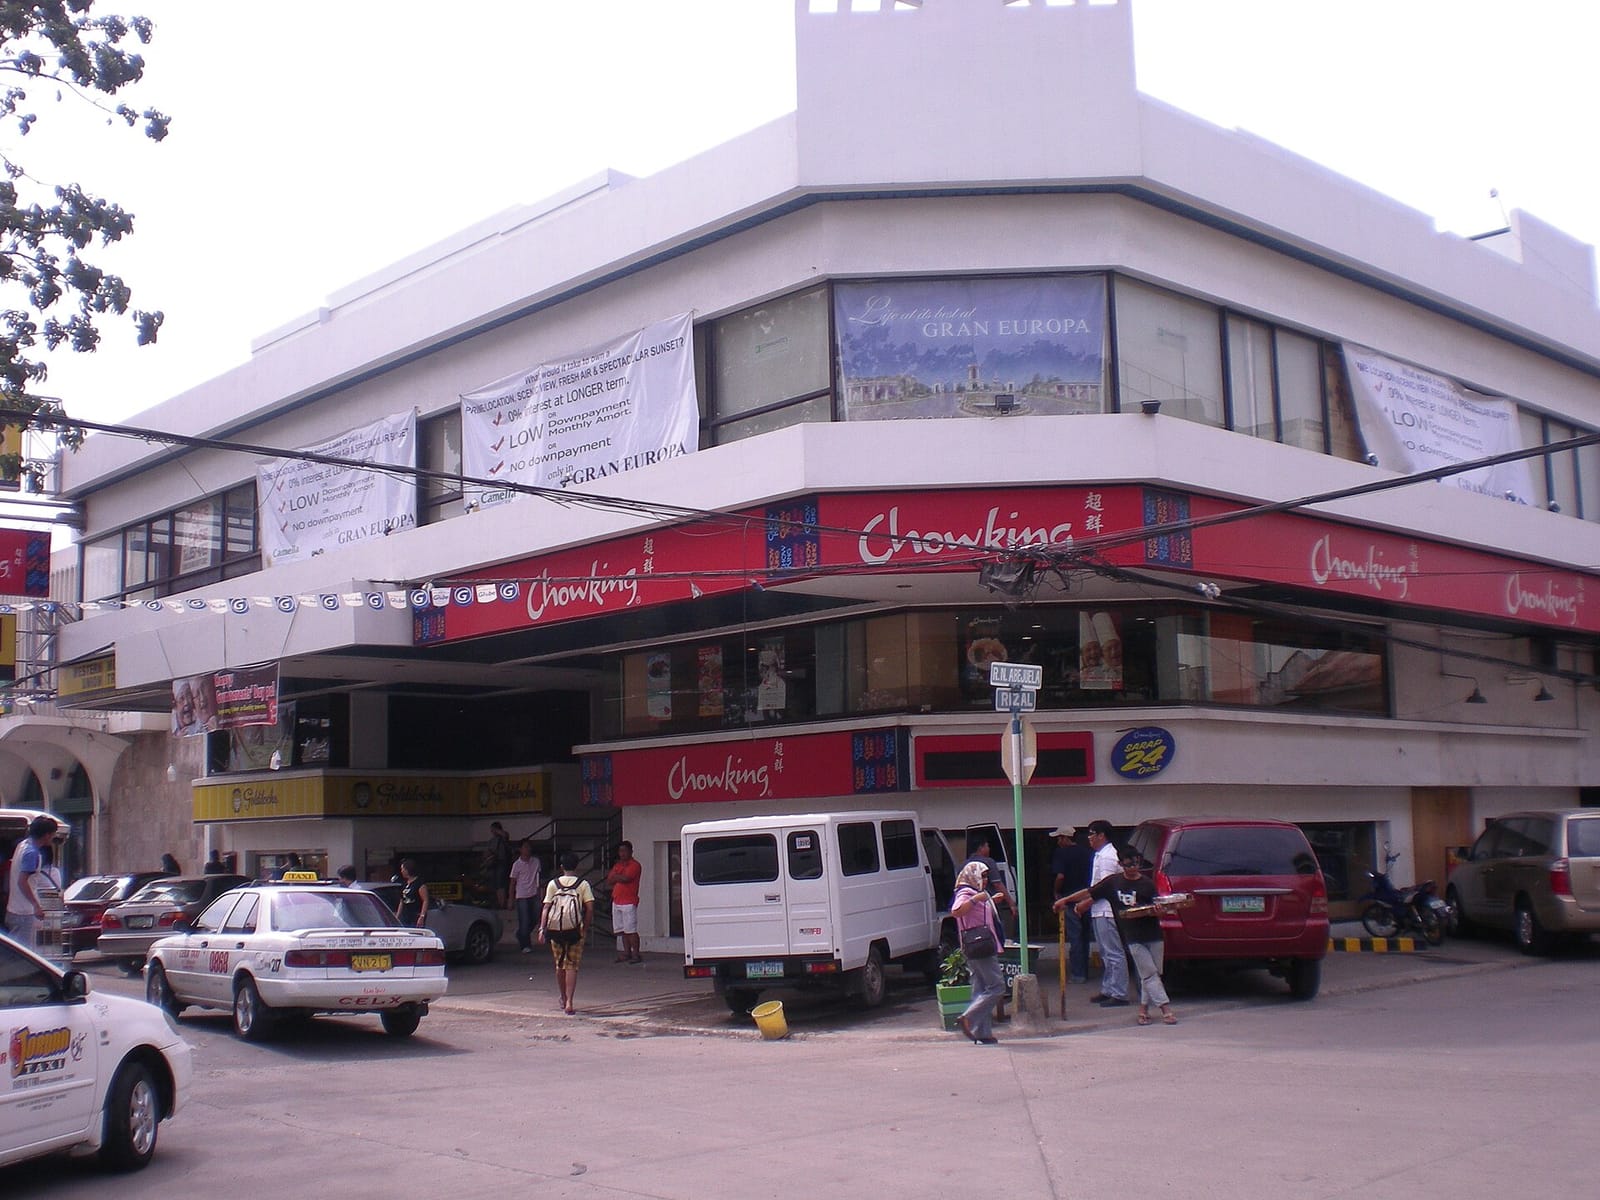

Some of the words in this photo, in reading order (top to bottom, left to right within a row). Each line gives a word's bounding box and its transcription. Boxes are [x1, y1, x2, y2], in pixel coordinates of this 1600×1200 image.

[923, 321, 989, 338] GRAN
[999, 318, 1090, 336] EUROPA
[558, 374, 580, 387] FRESH
[580, 370, 592, 381] AIR
[593, 366, 598, 376] &
[650, 337, 684, 357] SUNSET?
[508, 409, 522, 423] 0%
[554, 396, 564, 407] at
[566, 382, 604, 403] LONGER
[548, 398, 631, 428] Downpayment
[548, 419, 592, 437] Monthly
[595, 408, 632, 425] Amort.
[1391, 409, 1429, 432] LOW
[509, 424, 544, 449] LOW
[510, 461, 525, 473] NO
[528, 437, 612, 469] downpayment
[573, 459, 620, 485] GRAN
[623, 441, 687, 471] EUROPA
[289, 491, 320, 511] LOW
[292, 521, 305, 531] NO
[307, 505, 364, 529] downpayment
[338, 524, 367, 544] GRAN
[370, 512, 415, 536] EUROPA
[858, 506, 1073, 565] Chowking
[1311, 534, 1408, 599] Chowking
[527, 560, 638, 620] Chowking
[1505, 570, 1577, 625] Chowking
[992, 664, 1008, 681] R.N.
[1008, 665, 1041, 685] ABEJUELA
[1001, 691, 1034, 707] RIZAL
[1120, 745, 1167, 771] 24
[1124, 739, 1163, 752] SARAP
[668, 755, 768, 800] Chowking
[25, 1060, 64, 1074] TAXI
